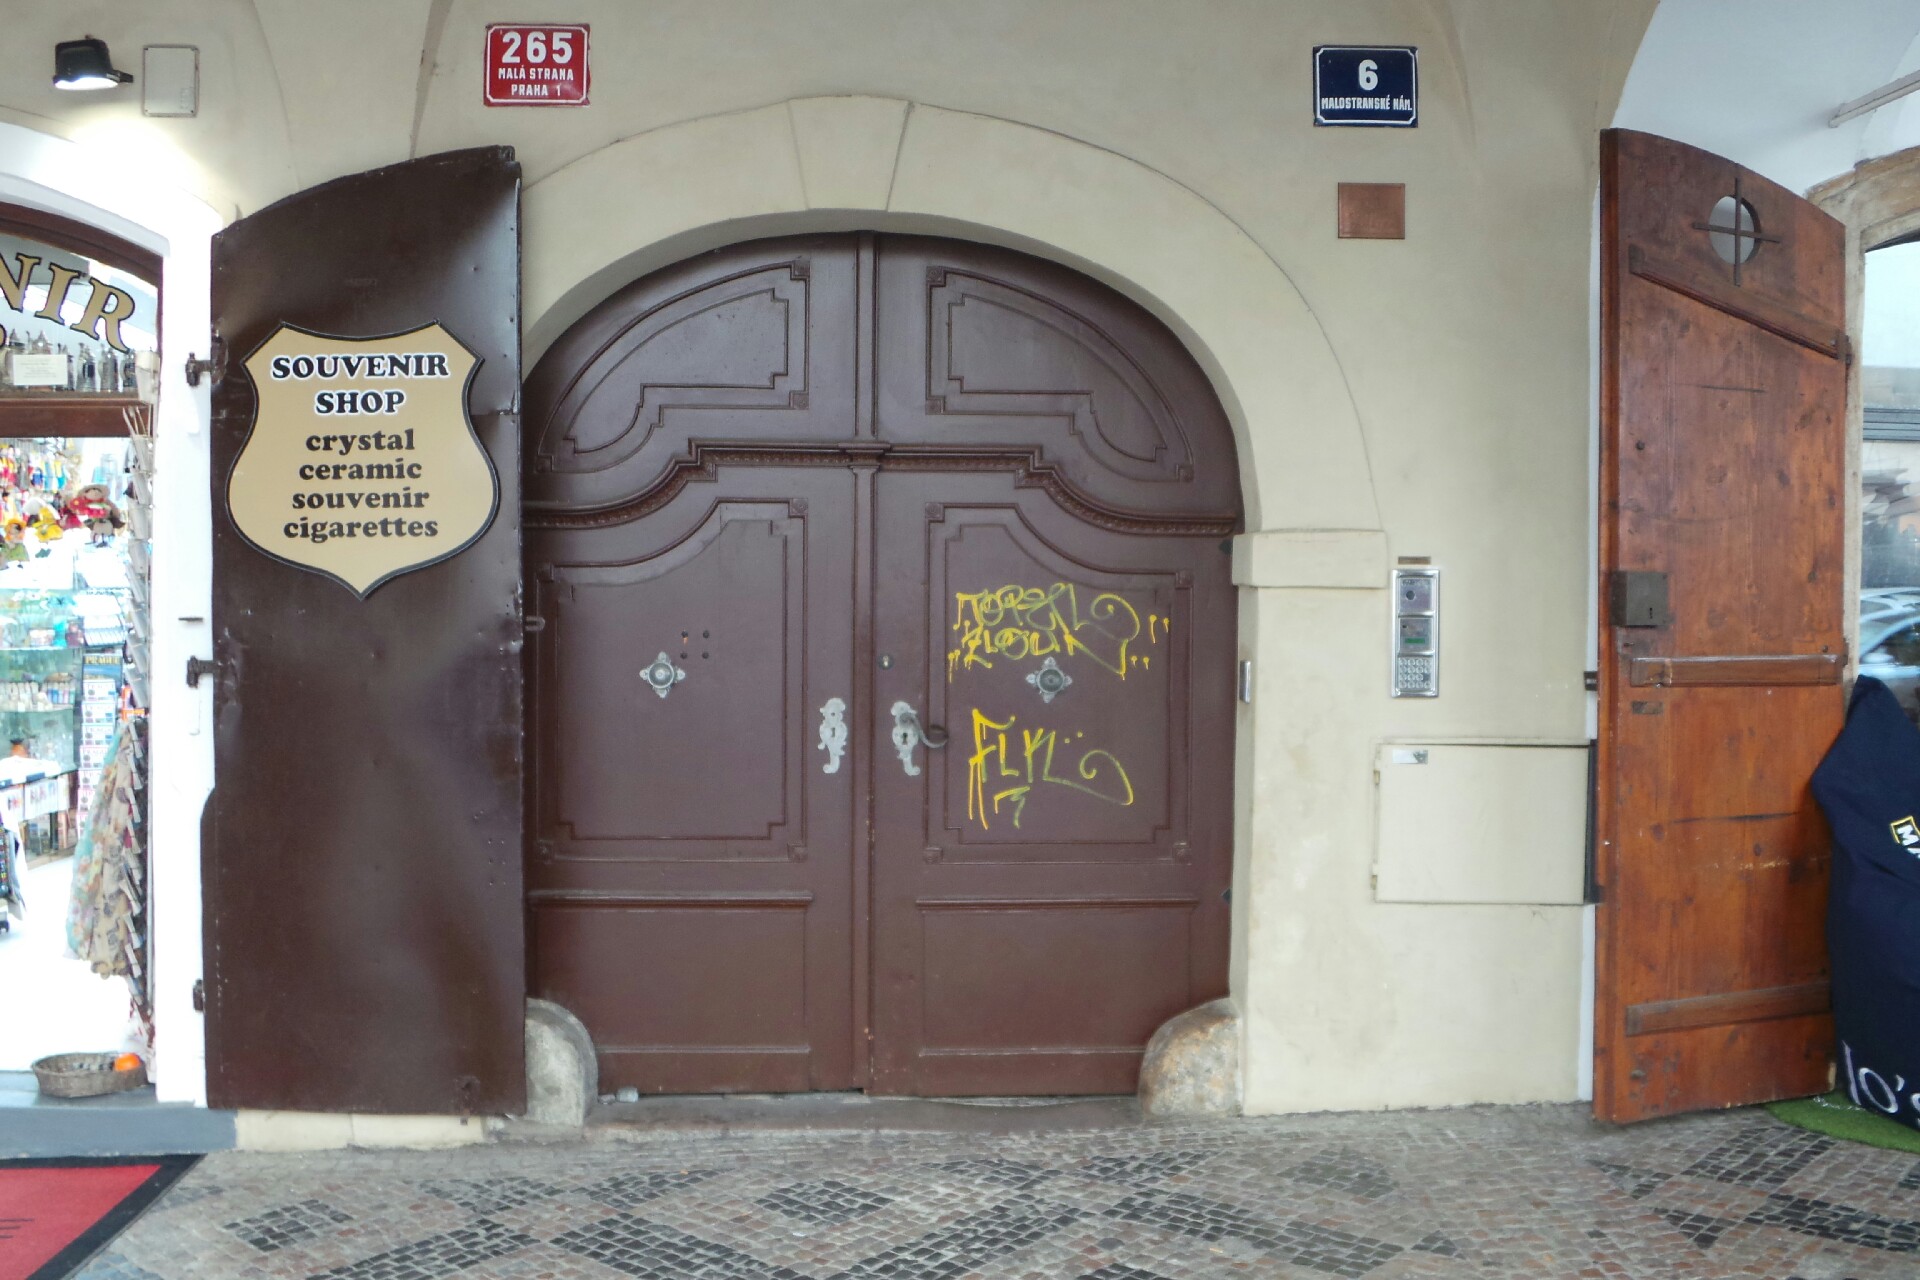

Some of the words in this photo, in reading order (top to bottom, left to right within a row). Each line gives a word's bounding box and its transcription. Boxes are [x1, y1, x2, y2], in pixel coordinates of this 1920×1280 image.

[501, 31, 573, 64] 265
[498, 64, 526, 80] MALÁ
[529, 67, 574, 81] STRANA
[1358, 59, 1378, 91] 6
[511, 84, 548, 96] PRAHA
[556, 84, 561, 96] 1
[1321, 94, 1391, 110] MALOSTRANSKÉ
[271, 353, 450, 379] SOUVENIR
[314, 389, 406, 415] SHOP
[305, 428, 416, 456] crystal
[299, 458, 422, 480] ceramic
[292, 487, 430, 509] souvenir
[283, 517, 438, 544] cigarettes
